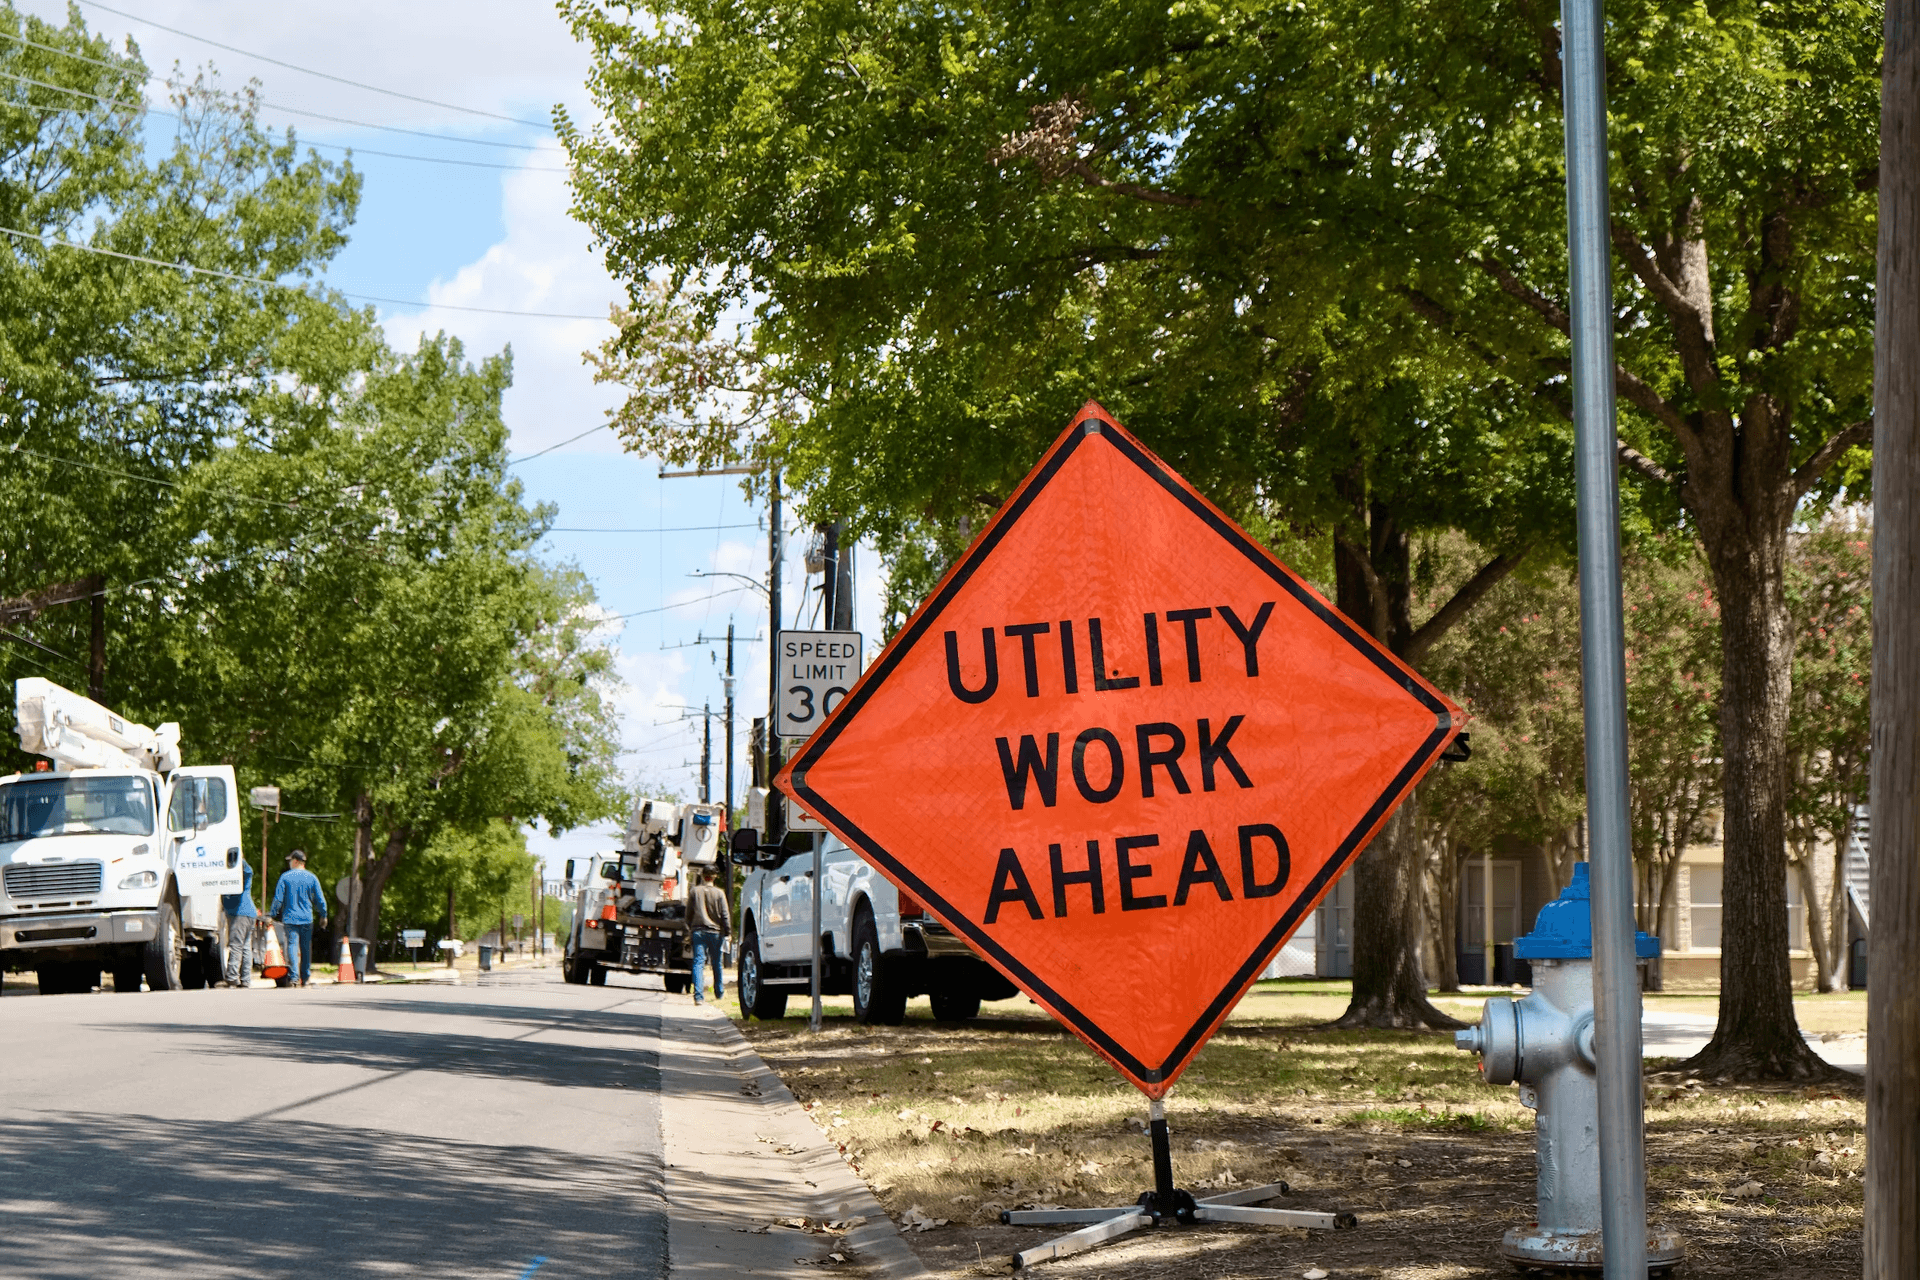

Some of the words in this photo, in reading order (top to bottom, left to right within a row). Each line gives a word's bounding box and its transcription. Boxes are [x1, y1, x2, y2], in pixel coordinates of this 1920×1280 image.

[786, 642, 855, 659] SPEED
[793, 664, 847, 680] LIMIT
[944, 601, 1277, 704] UTILITY
[995, 715, 1254, 811] WORK
[180, 860, 225, 870] STERLING
[983, 823, 1291, 925] AHEAD
